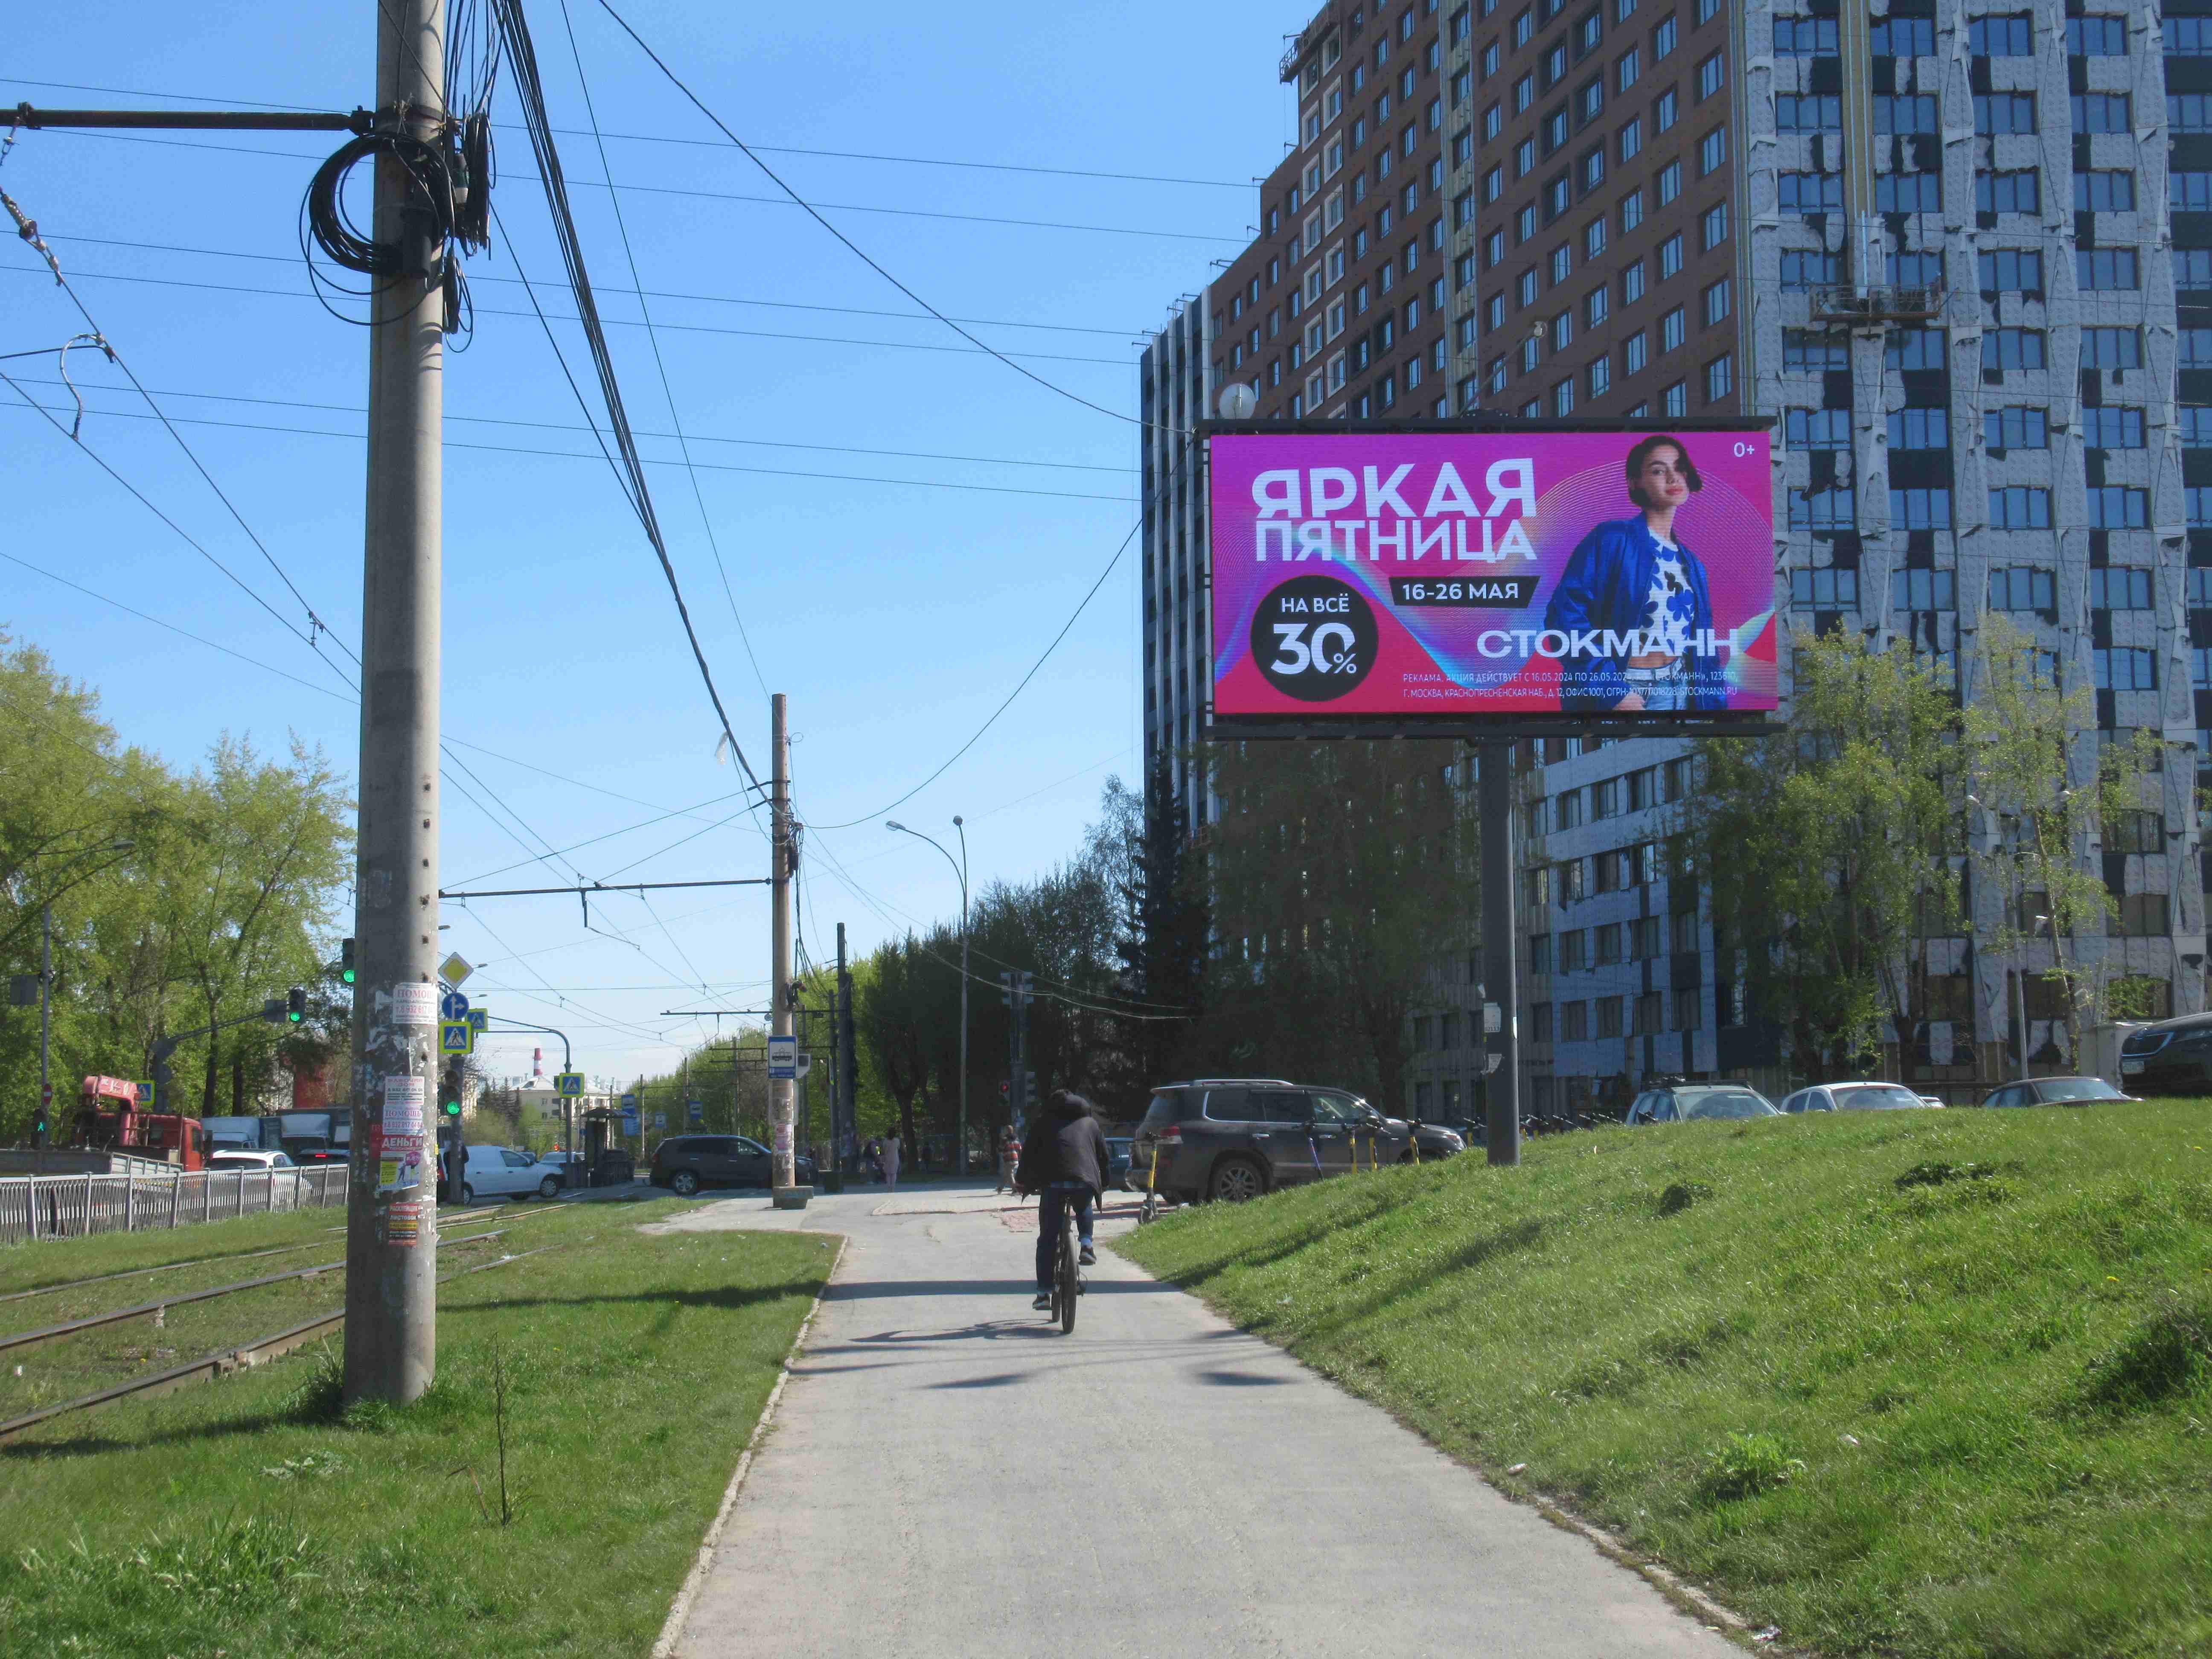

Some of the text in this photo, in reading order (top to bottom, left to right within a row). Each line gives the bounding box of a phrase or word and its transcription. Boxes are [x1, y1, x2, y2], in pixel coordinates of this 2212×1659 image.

[1734, 442, 1755, 457] 0+
[1252, 458, 1536, 518] ЯРКАЯ
[1256, 519, 1537, 563] ПЯТНИЦА
[1402, 582, 1519, 600] 16-26 МАЯ
[1281, 593, 1350, 613] НА ВСЁ
[1271, 622, 1357, 674] 30%
[1476, 629, 1738, 658] СТОКМАНН
[1403, 673, 1444, 683] РЕКЛАМА.
[1447, 673, 1473, 683] АКЦИЯ
[1476, 671, 1522, 683] ДЕЙСТВУЕТ
[1524, 673, 1530, 681] С
[1532, 672, 1573, 682] 16.05.2024
[1575, 672, 1587, 681] ПО
[1403, 689, 1409, 697] Г.
[1411, 689, 1444, 699] МОСКВА,
[1445, 688, 1526, 697] КРАСНОПРЕСНЕНСКАЯ
[382, 1137, 423, 1148] ДЕНЬГИ
